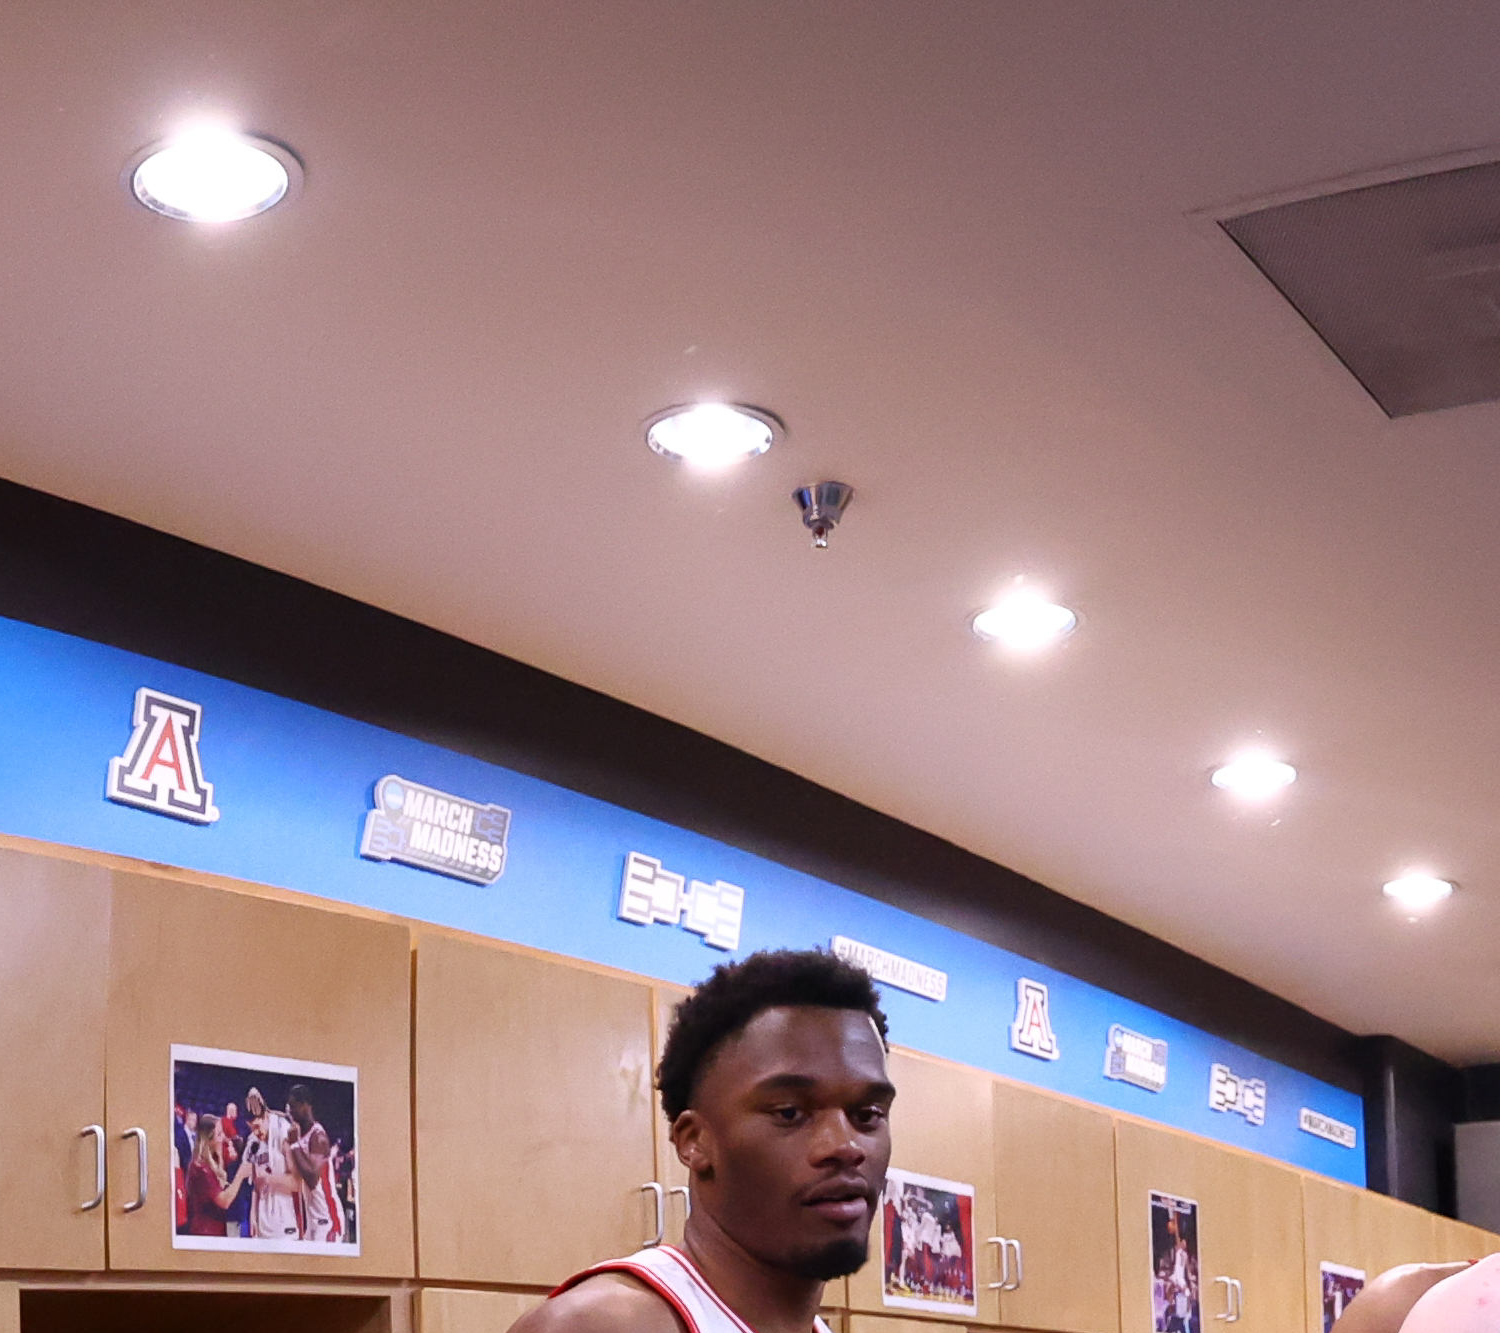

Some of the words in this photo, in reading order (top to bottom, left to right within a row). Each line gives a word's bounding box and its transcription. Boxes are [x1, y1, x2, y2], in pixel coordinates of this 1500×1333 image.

[114, 692, 210, 818] A
[402, 788, 475, 835] MARCH
[409, 820, 504, 873] MADNESS
[1017, 983, 1055, 1055] A
